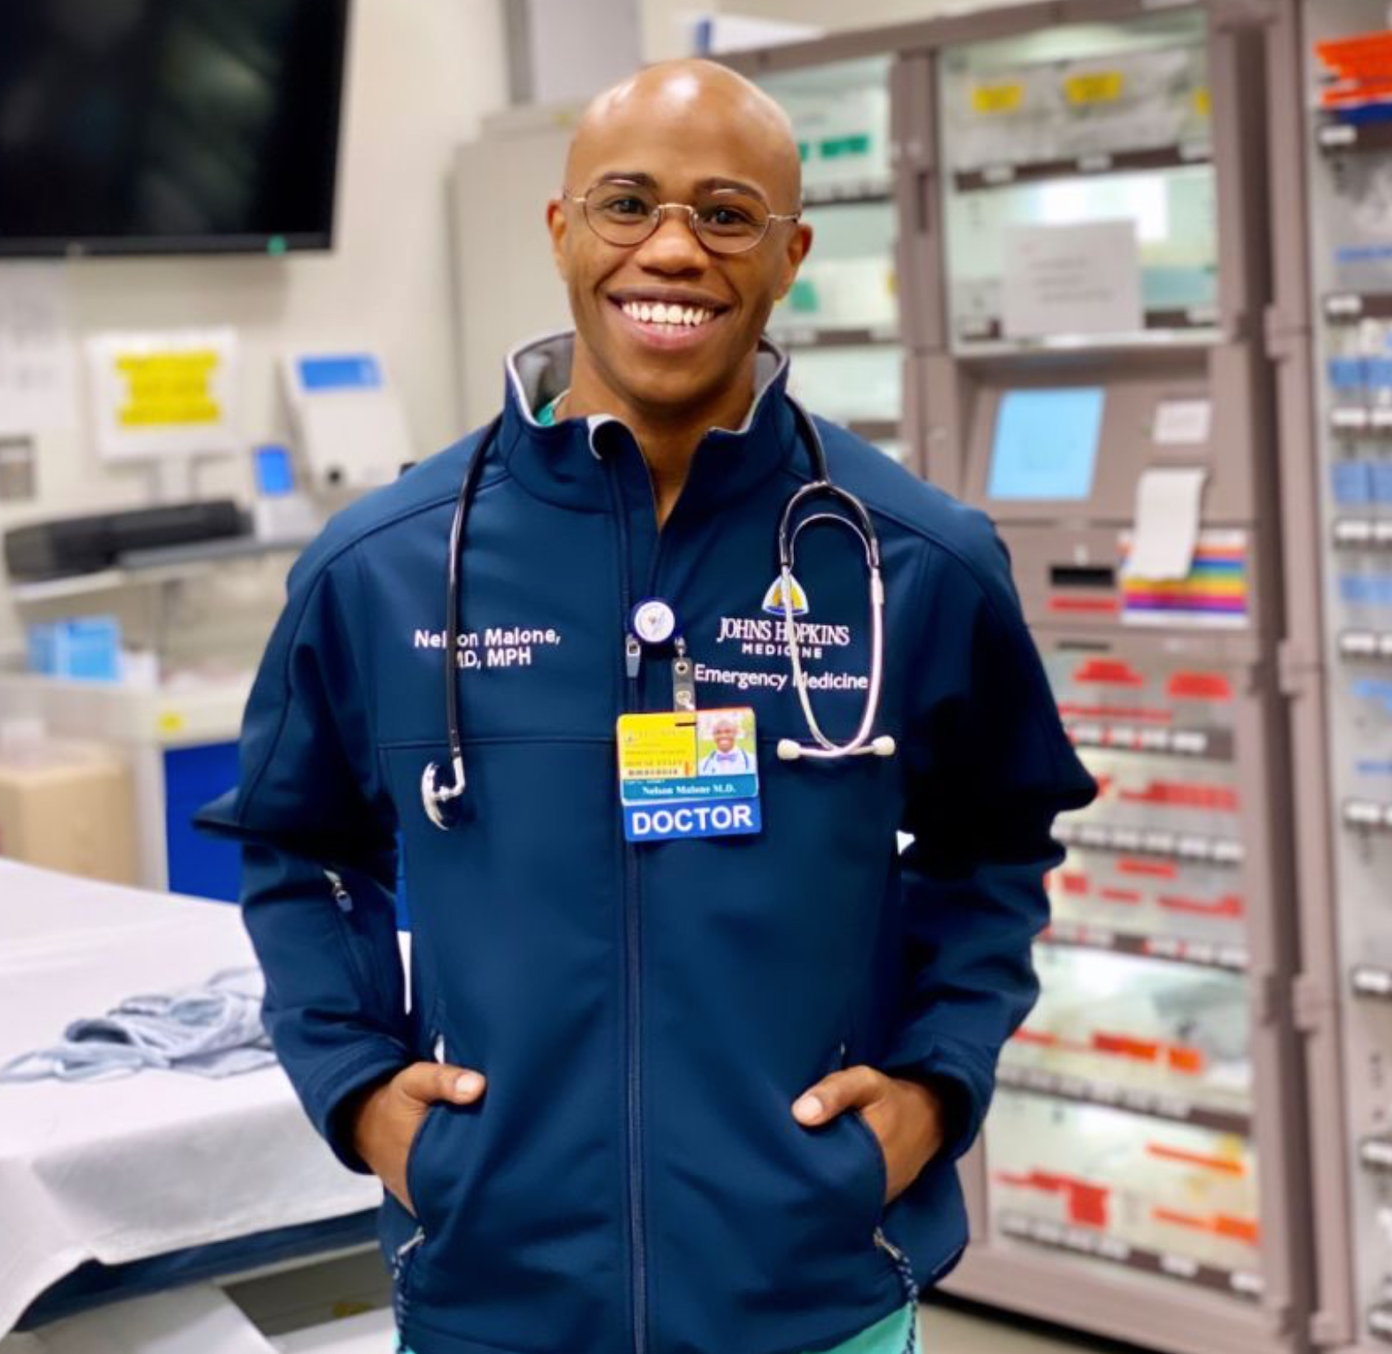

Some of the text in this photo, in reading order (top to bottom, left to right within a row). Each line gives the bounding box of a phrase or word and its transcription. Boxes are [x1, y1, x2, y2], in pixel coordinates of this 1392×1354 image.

[414, 626, 561, 648] Nelon Malone,
[716, 617, 771, 643] JOHNS
[487, 646, 532, 667] MPH
[742, 643, 822, 659] MEDICNE
[694, 664, 788, 691] Emergency
[632, 804, 754, 835] DOCTOR
